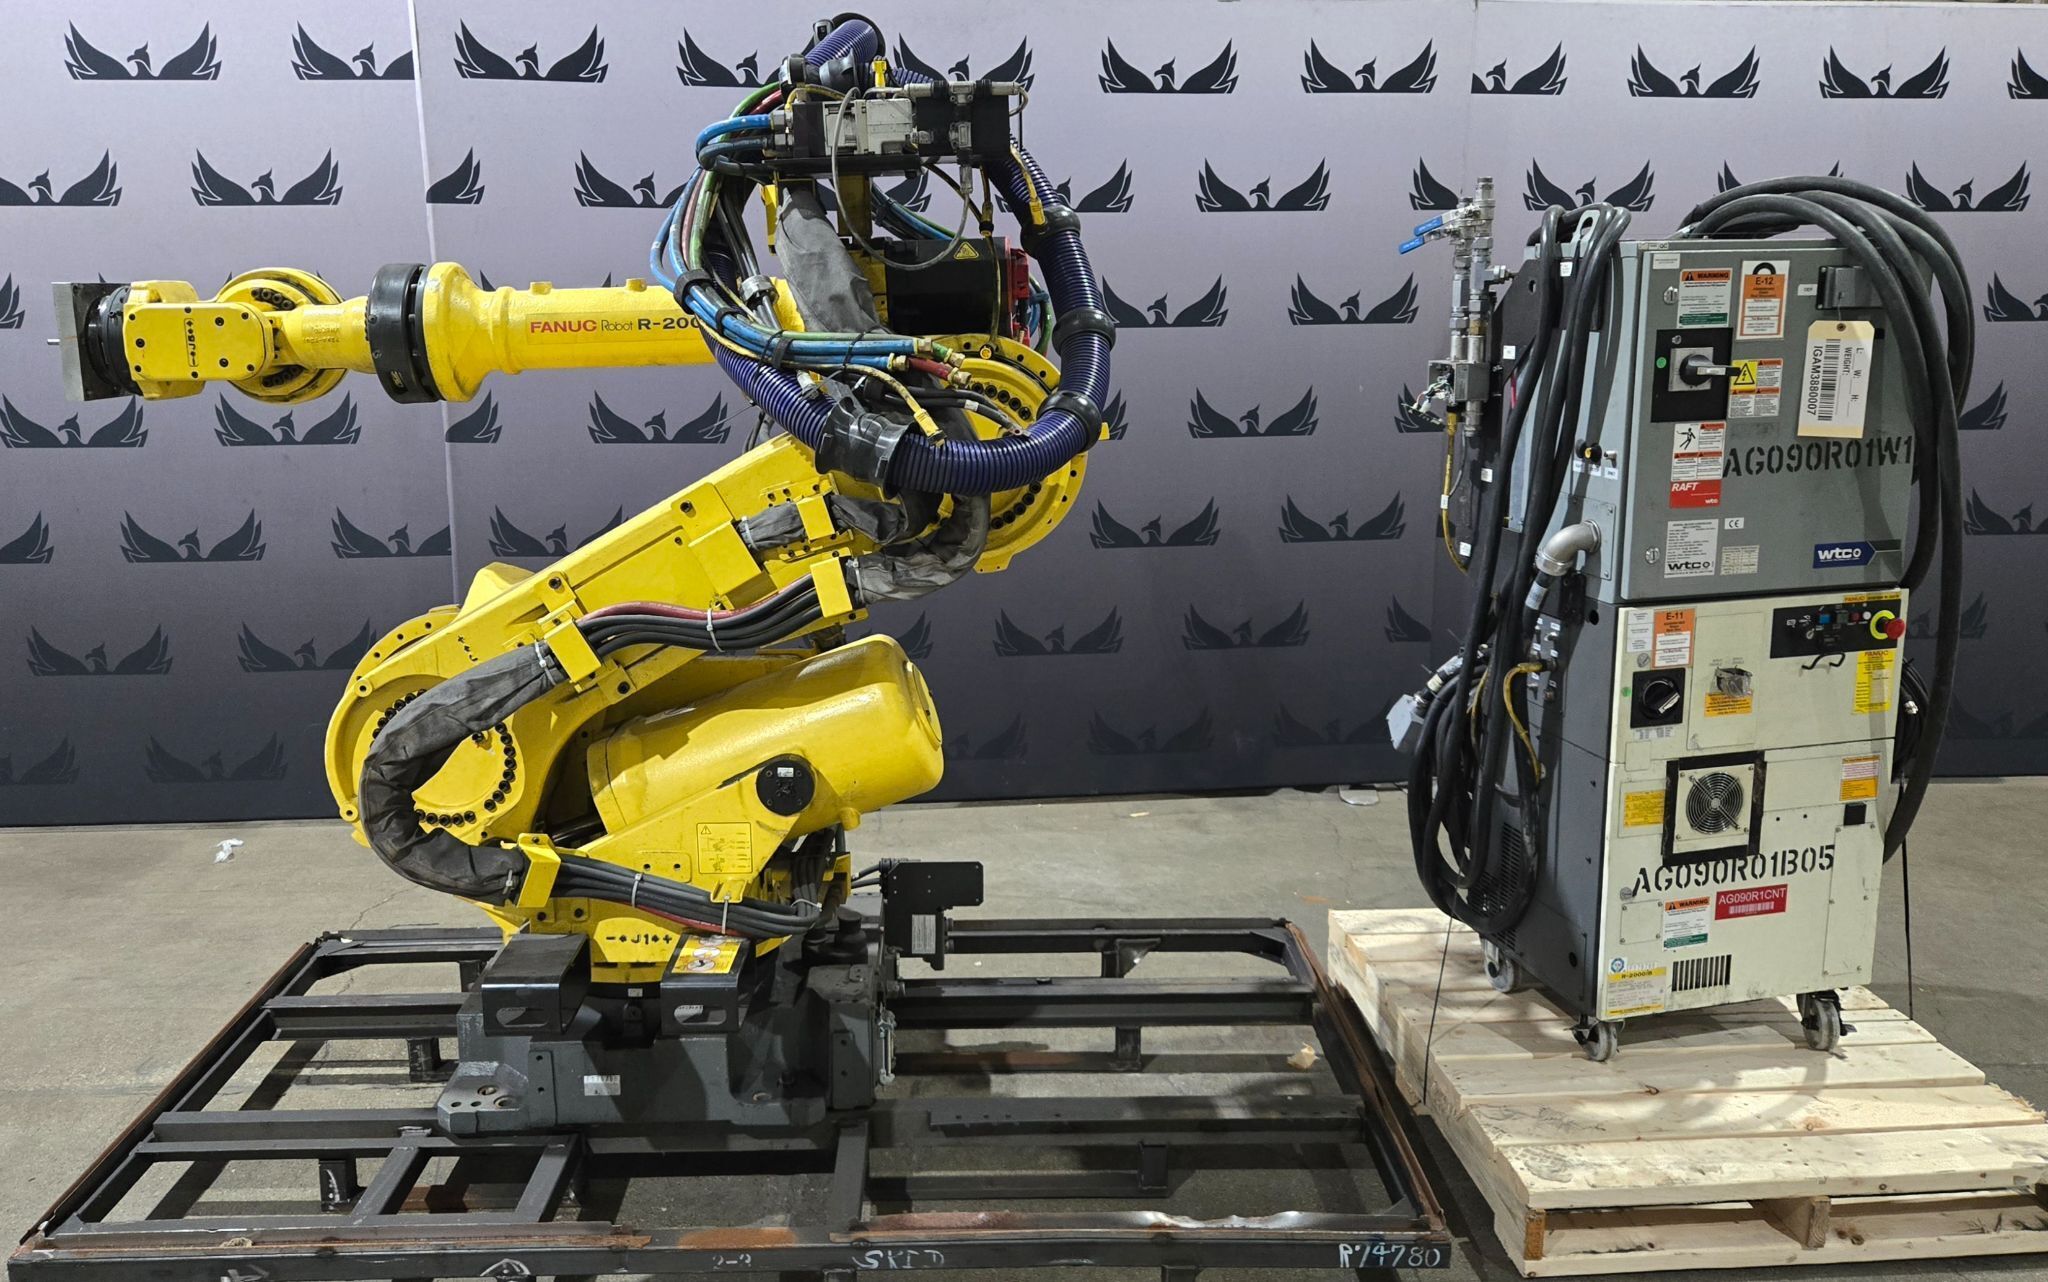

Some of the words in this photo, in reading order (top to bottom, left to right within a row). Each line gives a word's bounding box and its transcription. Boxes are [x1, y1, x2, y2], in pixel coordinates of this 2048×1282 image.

[1755, 276, 1774, 285] E-12
[530, 320, 597, 333] FANUC
[601, 319, 633, 332] Robot
[1841, 347, 1853, 376] WEIGHT:
[1806, 345, 1824, 416] IGAM3880007
[1722, 435, 1913, 479] AG090R01W1
[1671, 482, 1700, 492] RAFT
[1817, 547, 1862, 560] wtco
[1668, 561, 1711, 571] wtco
[1666, 612, 1684, 621] E-11
[1632, 844, 1836, 898] AG090R01B05
[1717, 887, 1787, 905] AG090R1CNT
